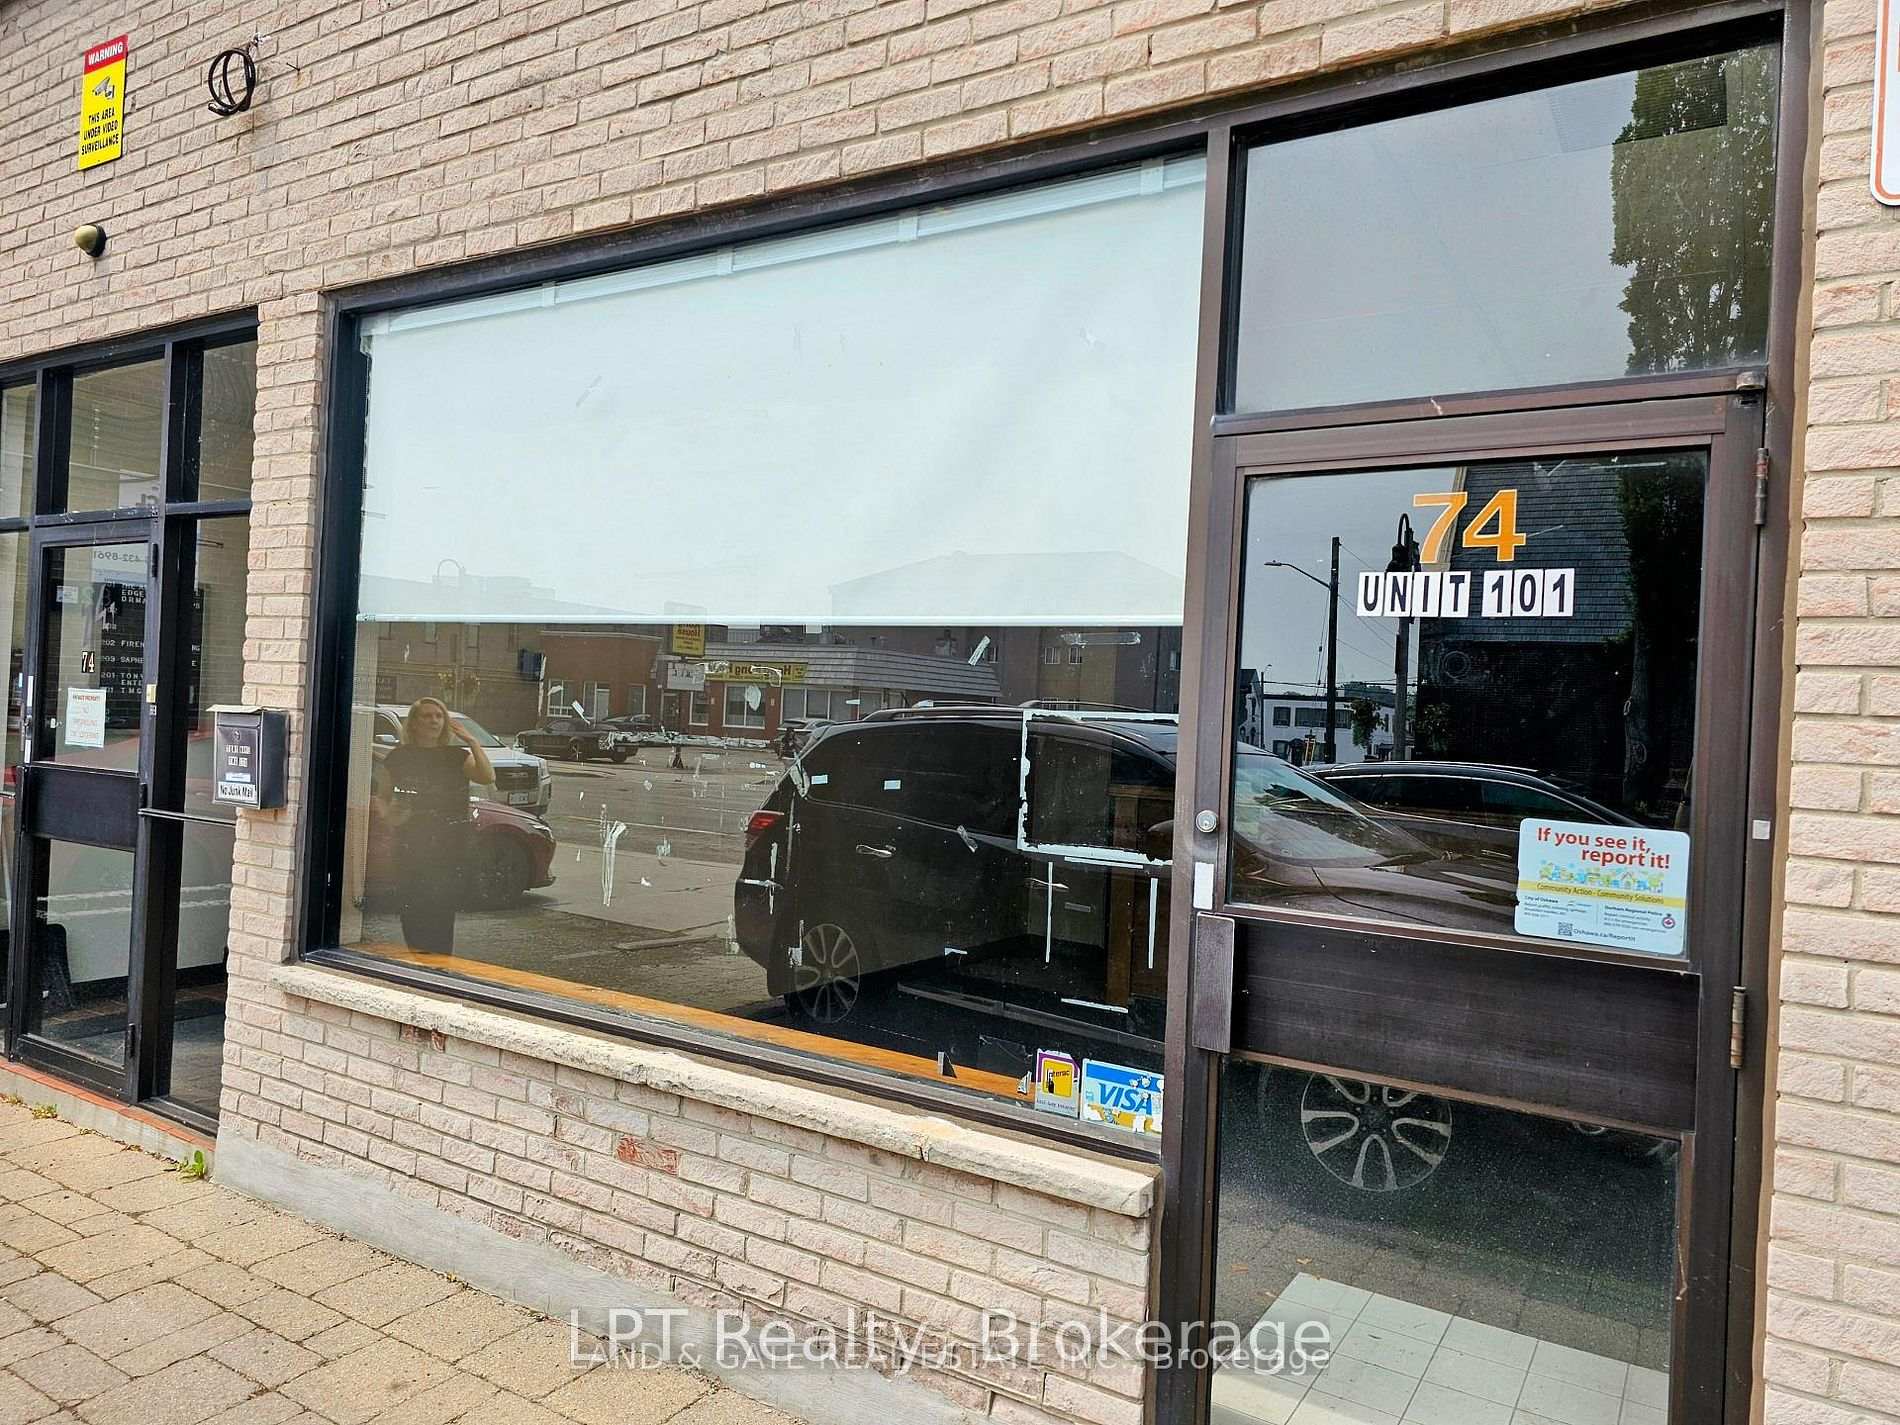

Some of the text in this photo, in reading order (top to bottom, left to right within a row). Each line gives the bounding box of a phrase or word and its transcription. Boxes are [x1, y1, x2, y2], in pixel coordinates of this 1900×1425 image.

[88, 42, 123, 65] WARNING
[88, 107, 115, 125] THIS AREA
[84, 120, 118, 141] UNDER VIDEO
[81, 134, 119, 155] SURVEILLANCE
[1413, 489, 1526, 563] 74
[1364, 573, 1566, 613] UNIT 101
[82, 652, 95, 672] 74
[1537, 827, 1651, 853] If you see it,
[1582, 848, 1670, 869] report it!
[1536, 882, 1572, 894] Community
[1572, 885, 1593, 896] Action
[1597, 889, 1634, 902] Community
[1635, 893, 1664, 905] Solutions
[1098, 1083, 1153, 1116] VISA
